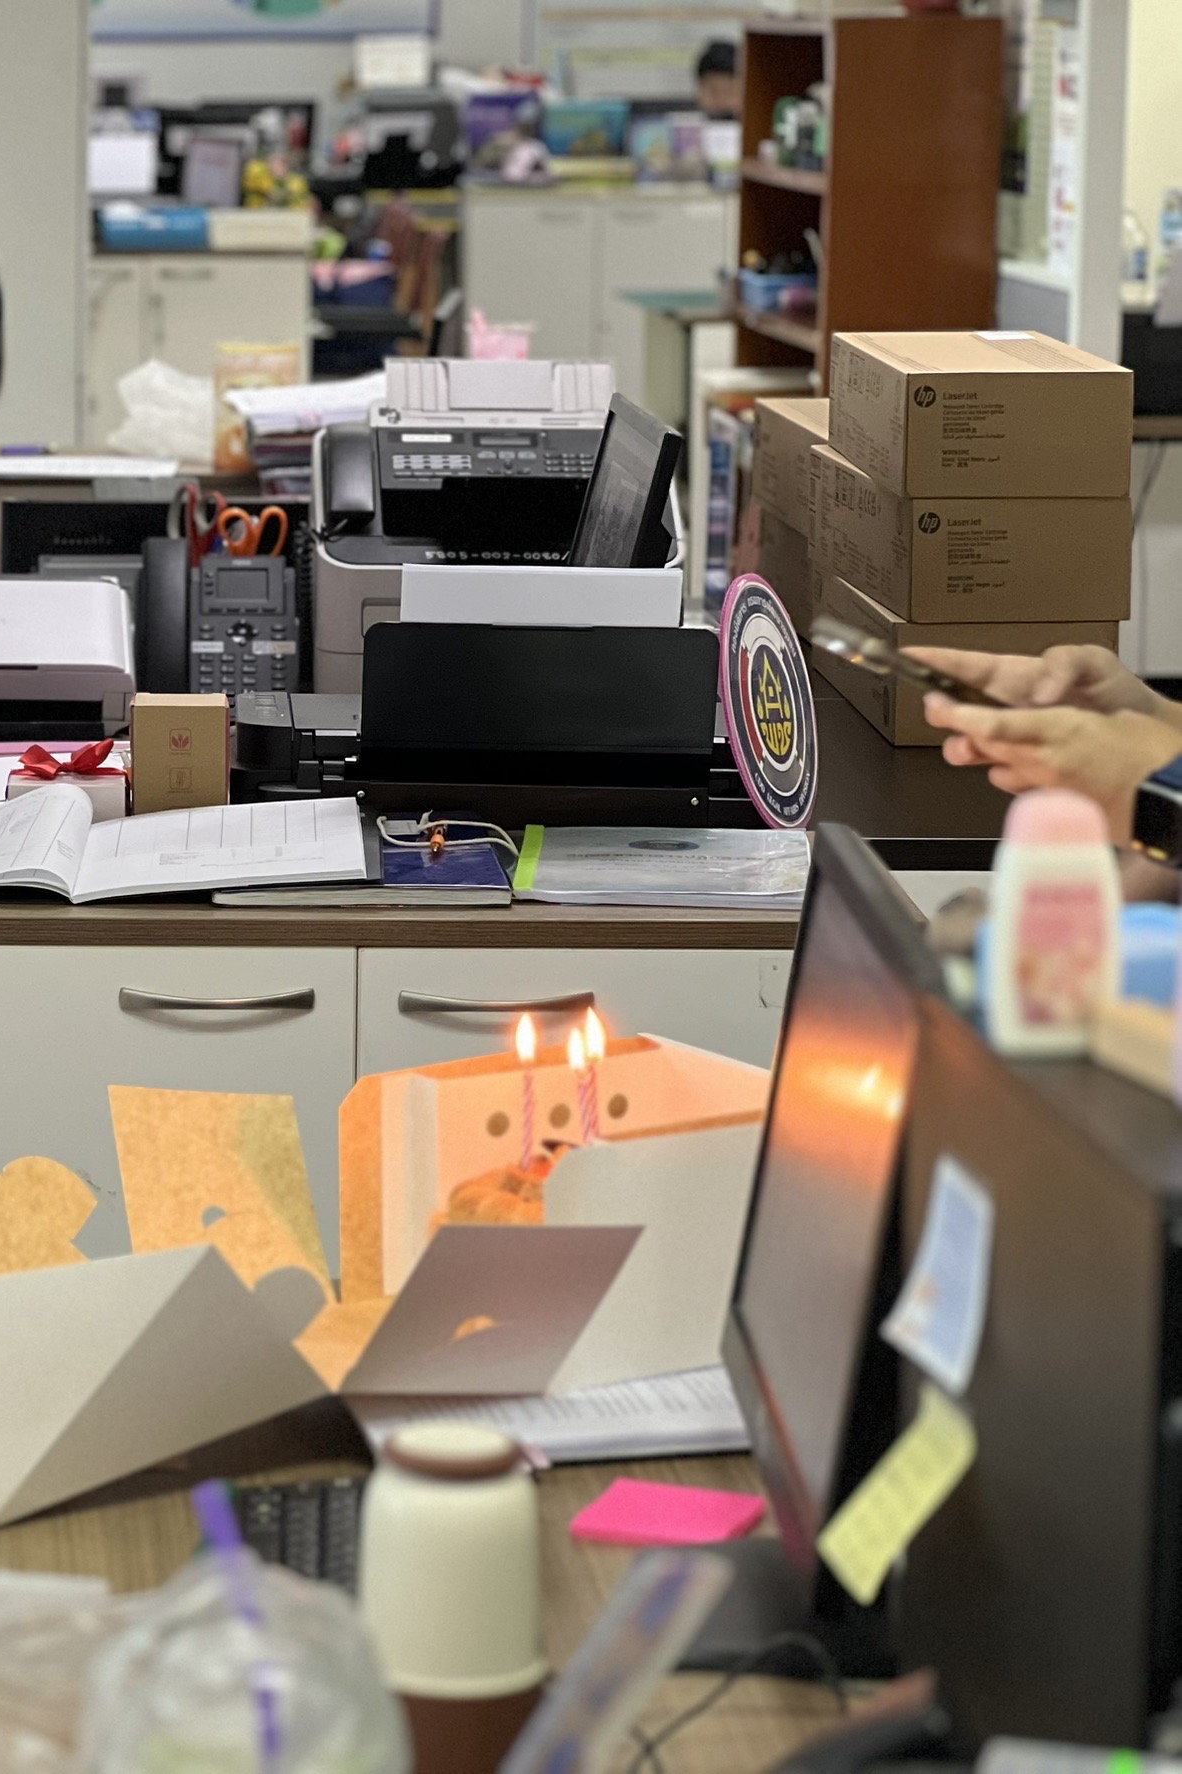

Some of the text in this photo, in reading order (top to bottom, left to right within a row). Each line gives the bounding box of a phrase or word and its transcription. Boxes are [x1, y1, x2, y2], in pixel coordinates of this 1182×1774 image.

[914, 385, 936, 408] hp
[943, 392, 978, 401] LaserJet
[918, 512, 941, 534] hp
[947, 517, 982, 526] LaserJet
[766, 792, 782, 814] LEGAL
